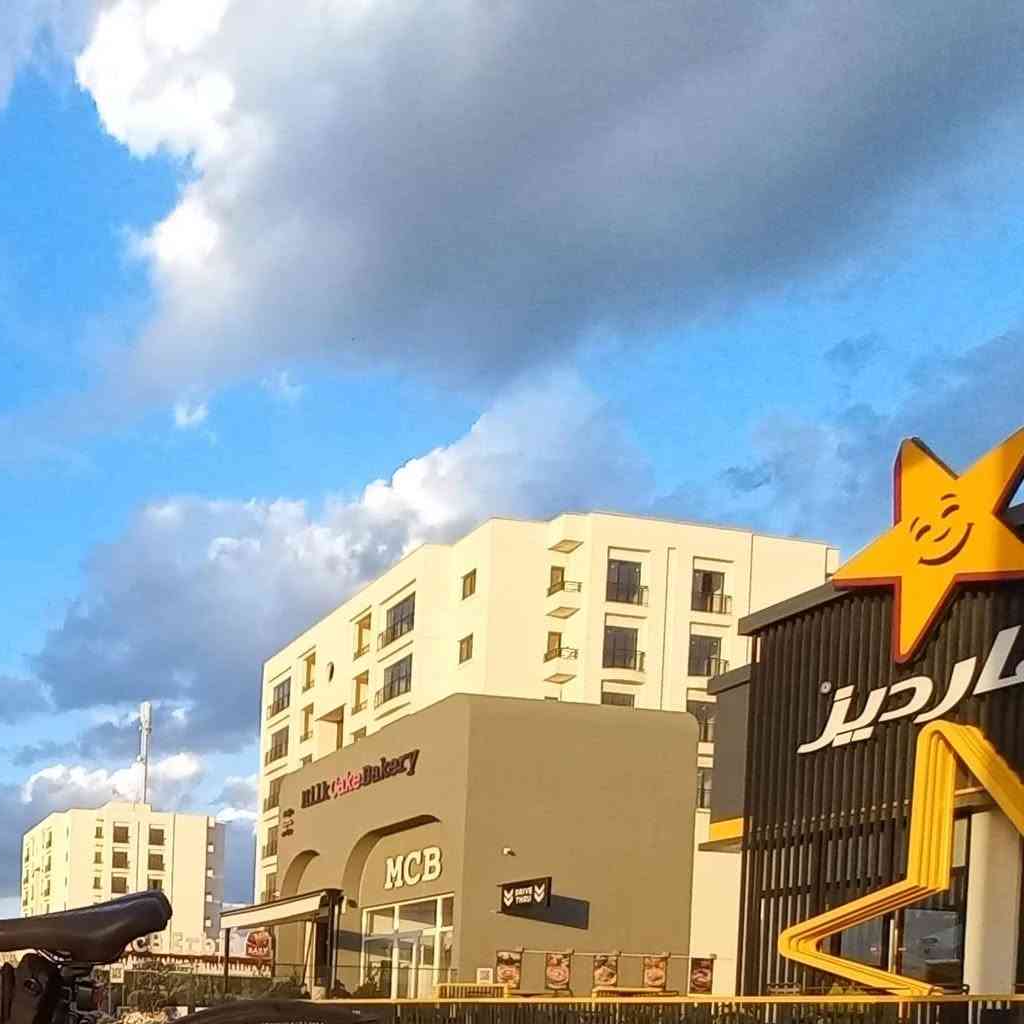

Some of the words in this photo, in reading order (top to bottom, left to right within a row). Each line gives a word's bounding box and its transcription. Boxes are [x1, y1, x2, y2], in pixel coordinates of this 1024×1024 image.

[797, 624, 1024, 754] ارديز
[361, 749, 420, 786] Bakery
[384, 846, 442, 889] MCB
